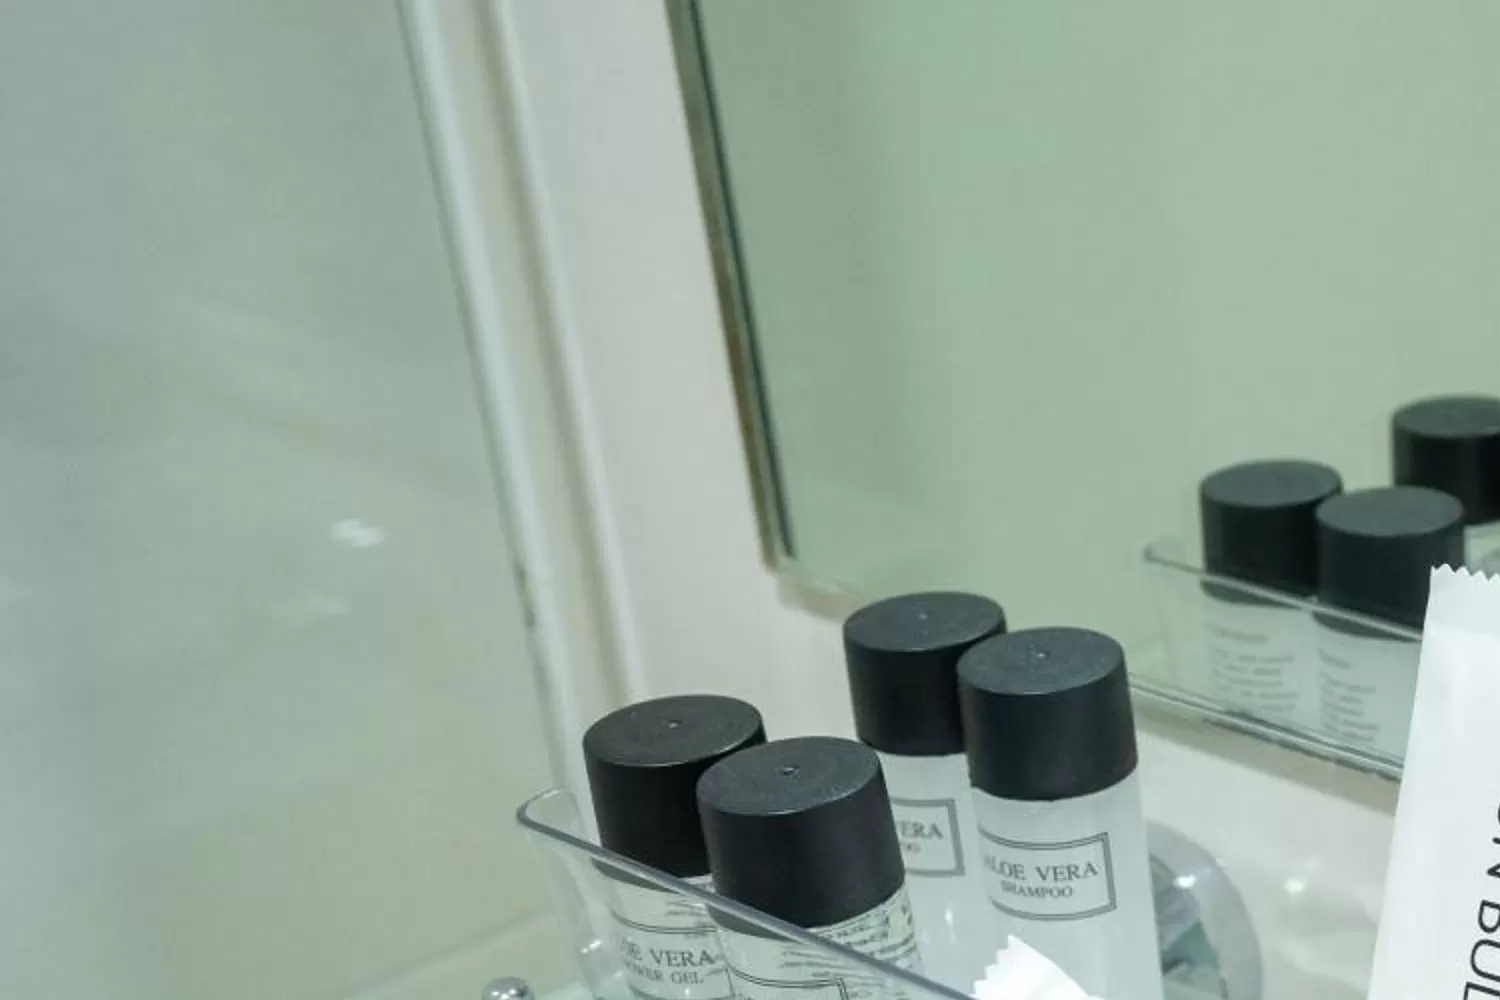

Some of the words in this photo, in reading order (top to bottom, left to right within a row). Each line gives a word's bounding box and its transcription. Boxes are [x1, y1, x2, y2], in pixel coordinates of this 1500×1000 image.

[895, 819, 944, 841] ERA
[1035, 861, 1099, 882] VERA
[649, 947, 716, 967] VERA
